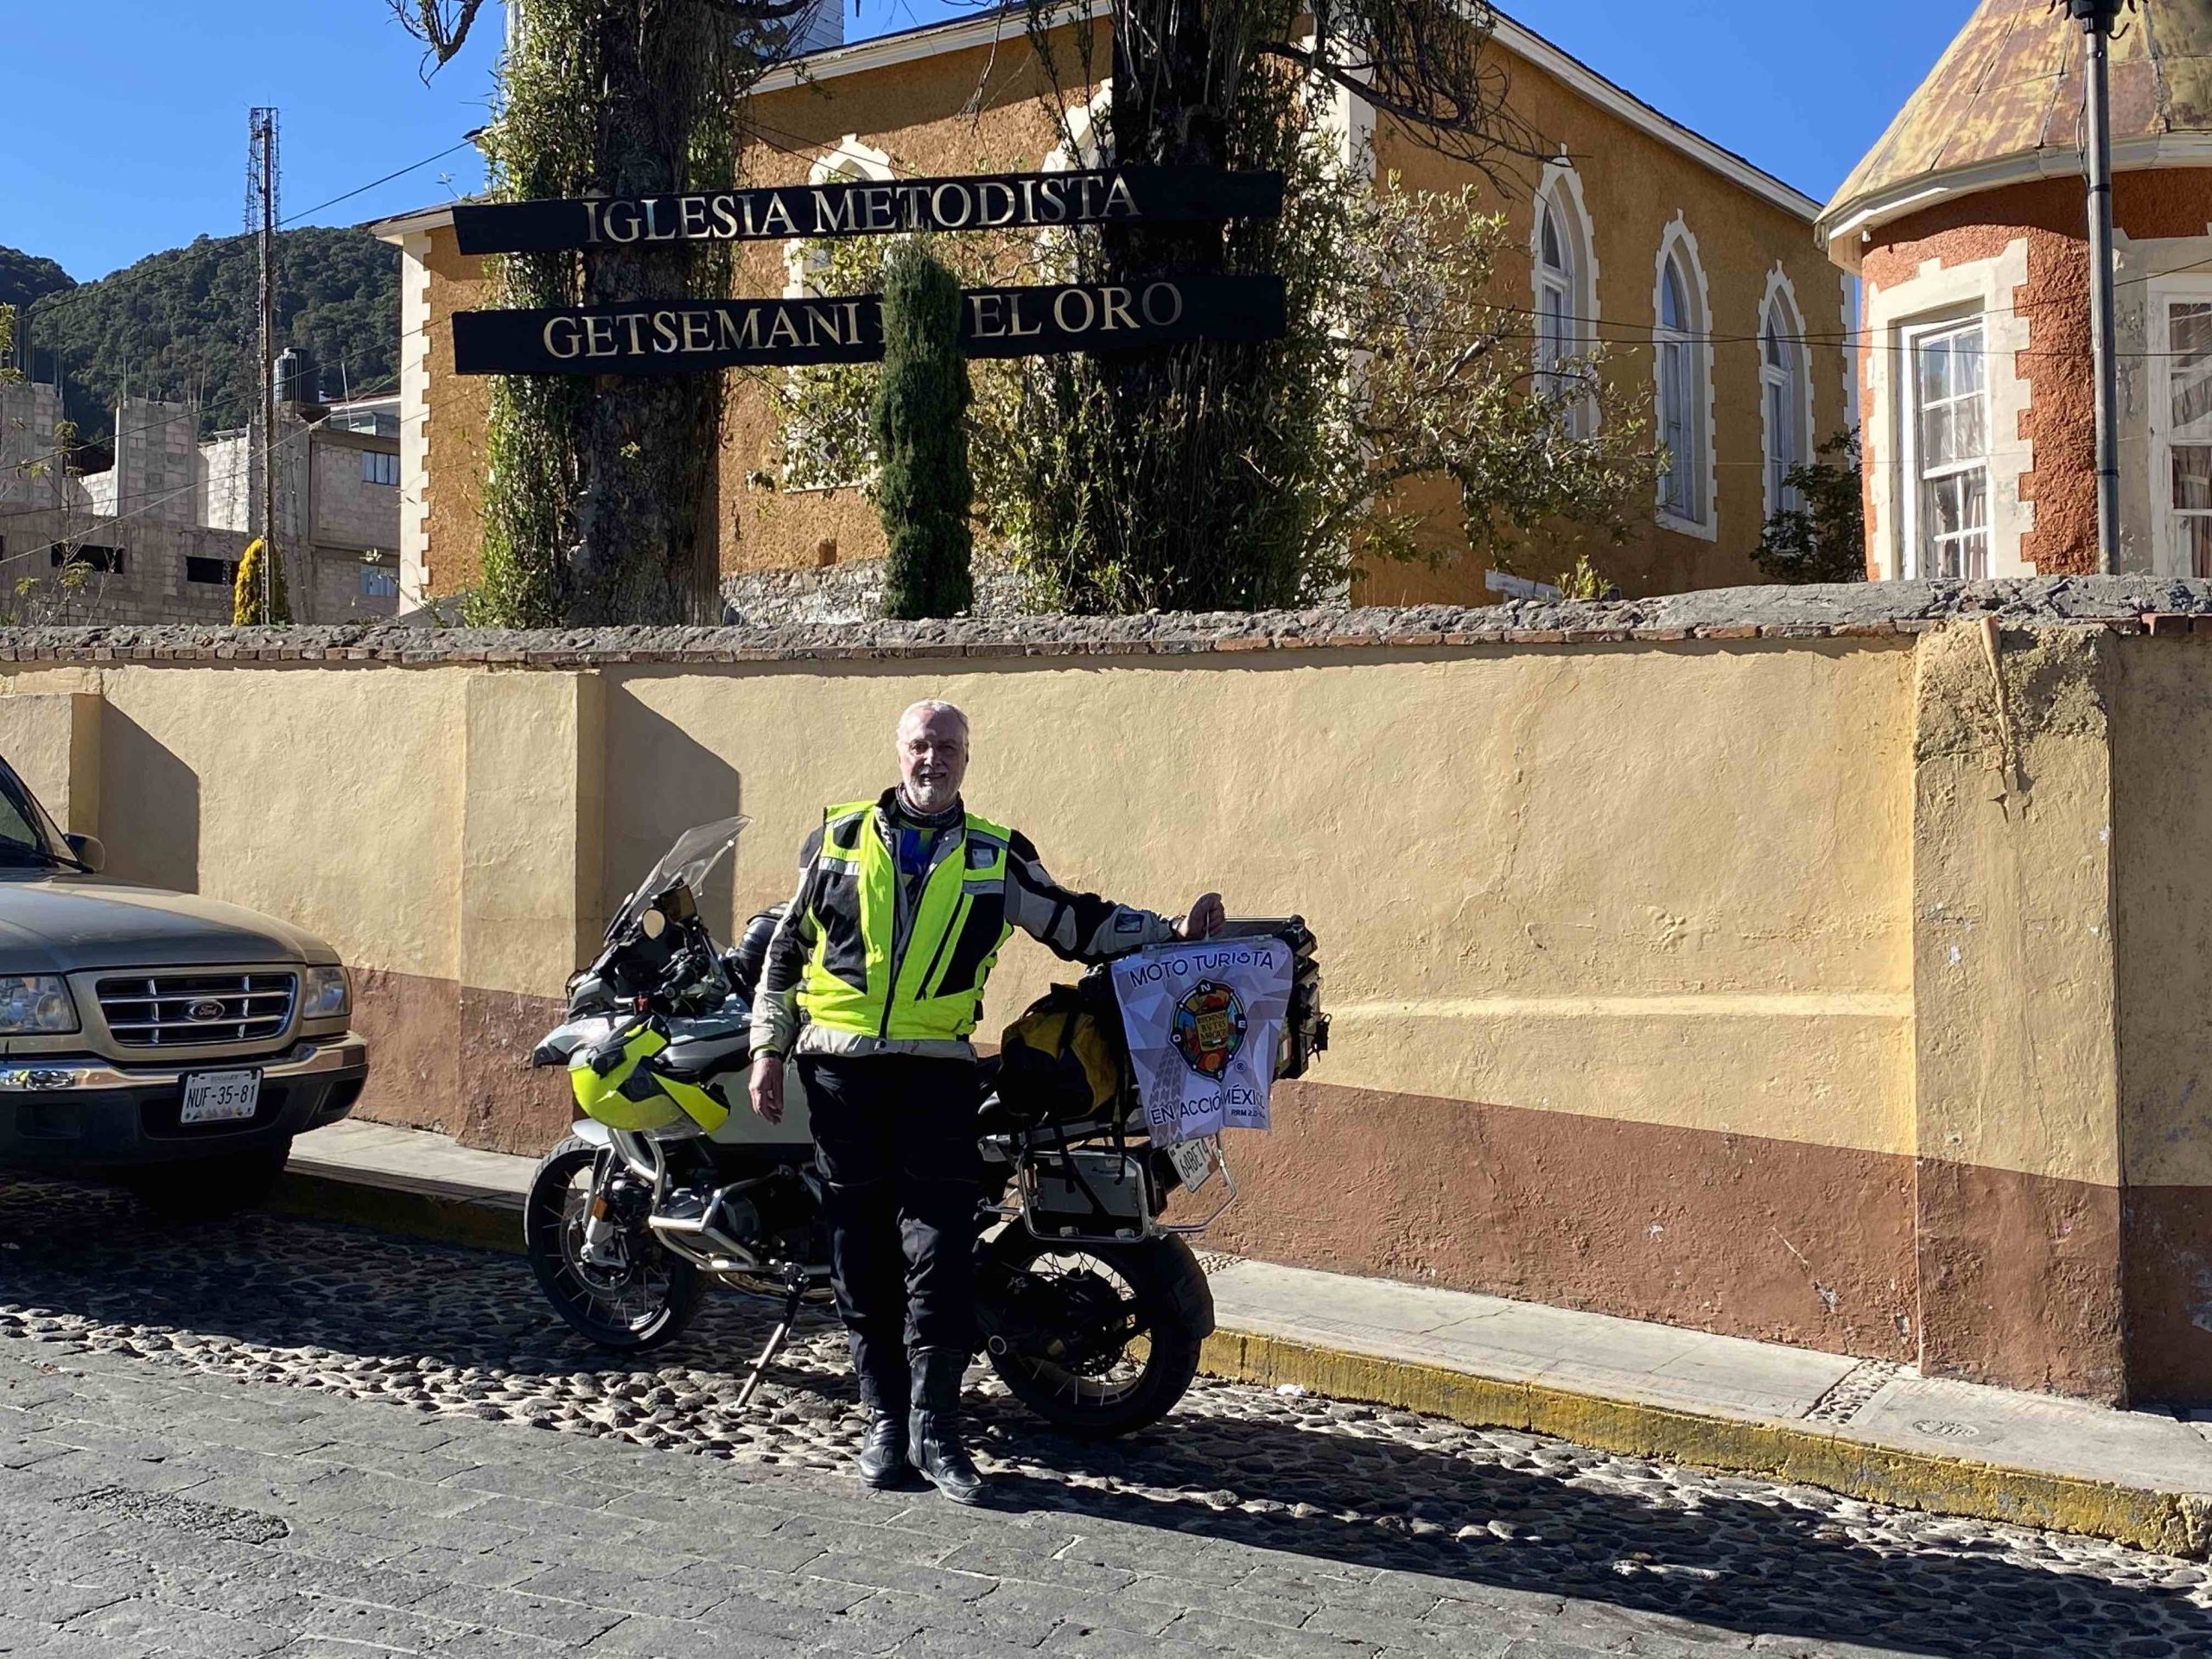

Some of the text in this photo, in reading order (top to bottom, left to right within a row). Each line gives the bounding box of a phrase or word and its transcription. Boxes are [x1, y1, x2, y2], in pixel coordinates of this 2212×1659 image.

[582, 174, 1141, 244] IGLESIA METODISTA
[543, 302, 863, 359] GETSEMANI
[1054, 282, 1183, 334] ORO
[1129, 950, 1274, 988] MOTO TURISTA
[1200, 983, 1211, 993] N
[199, 1004, 218, 1016] Ford
[186, 1084, 257, 1109] NUF-35-81
[1150, 1105, 1175, 1125] EN
[1179, 1090, 1222, 1118] ACCIÓ
